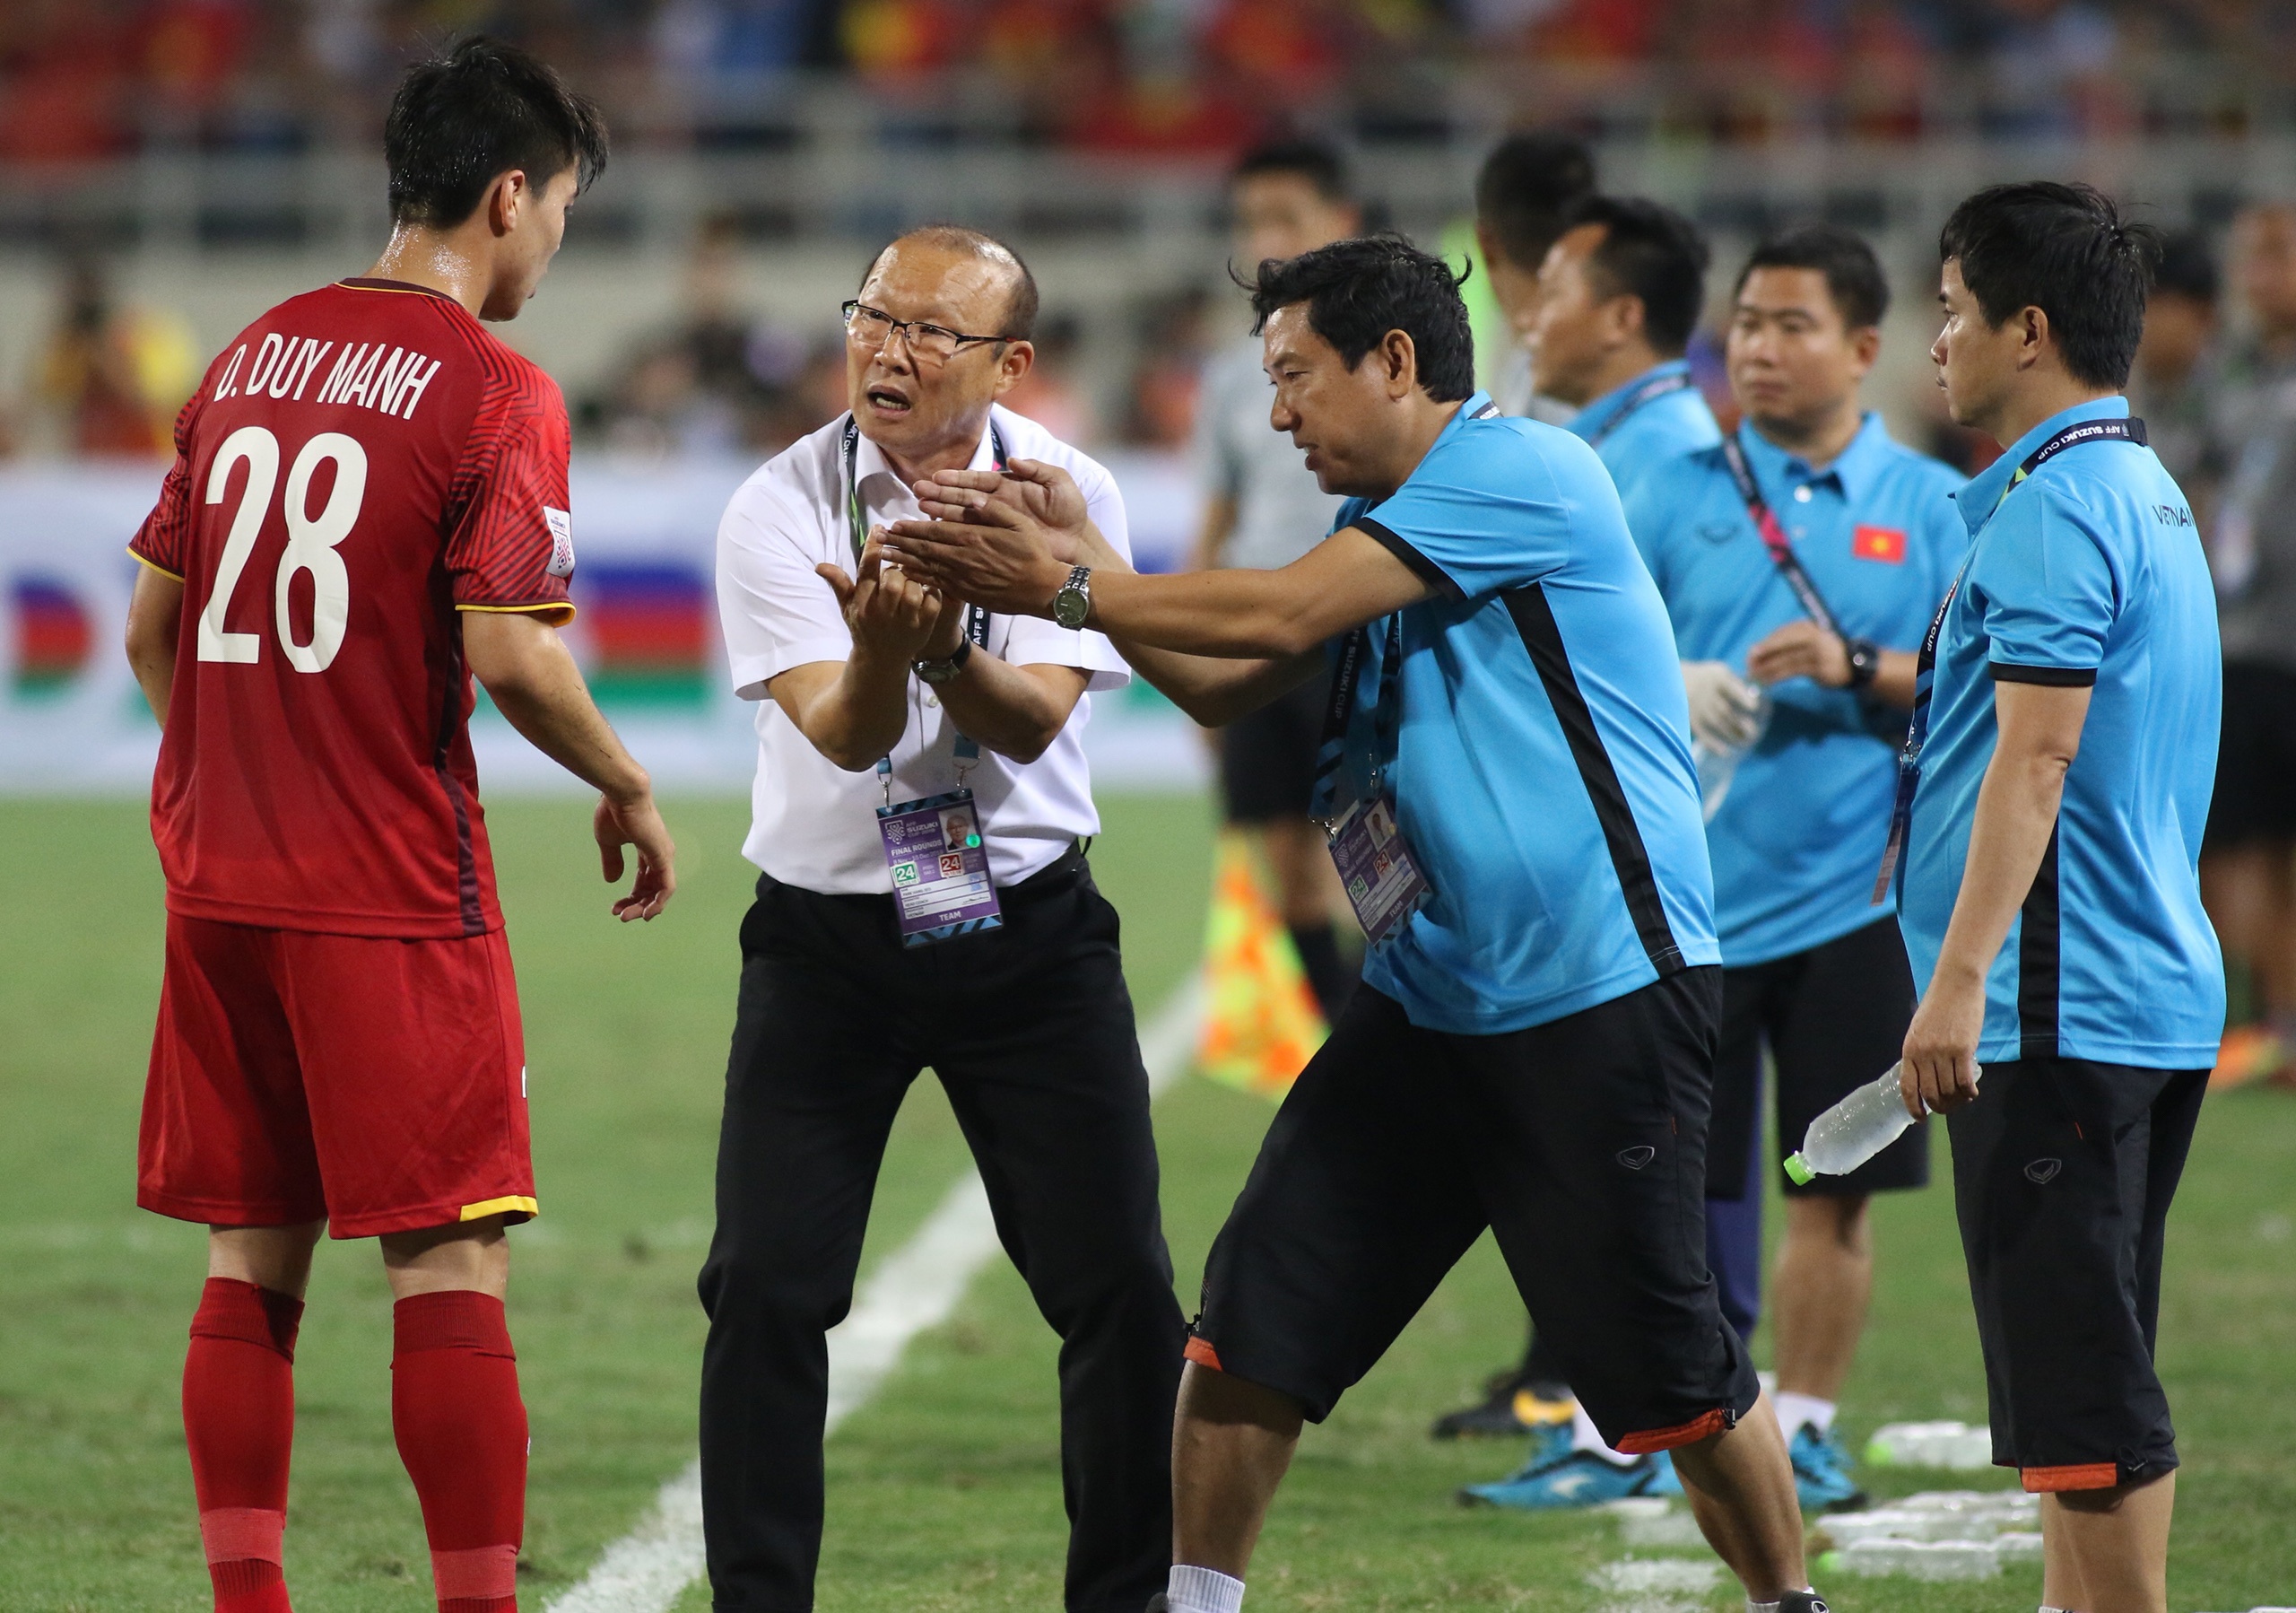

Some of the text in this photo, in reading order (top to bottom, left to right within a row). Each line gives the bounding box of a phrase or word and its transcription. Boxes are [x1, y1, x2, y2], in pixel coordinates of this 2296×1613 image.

[245, 333, 334, 401] DUY
[317, 342, 442, 420] MANH
[2038, 425, 2121, 461] AFF SUZUKI CUP
[197, 426, 368, 674] 28
[972, 606, 985, 645] AFF S
[1926, 626, 1937, 652] CUP
[1335, 630, 1360, 719] FF SUZUKI CUP
[907, 822, 938, 833] SUZUKI
[891, 840, 943, 857] FINAL ROUNDS
[942, 858, 960, 872] 24
[1376, 853, 1389, 872] 24
[897, 868, 916, 881] 24
[1351, 879, 1366, 899] 24
[939, 911, 961, 922] TEAM
